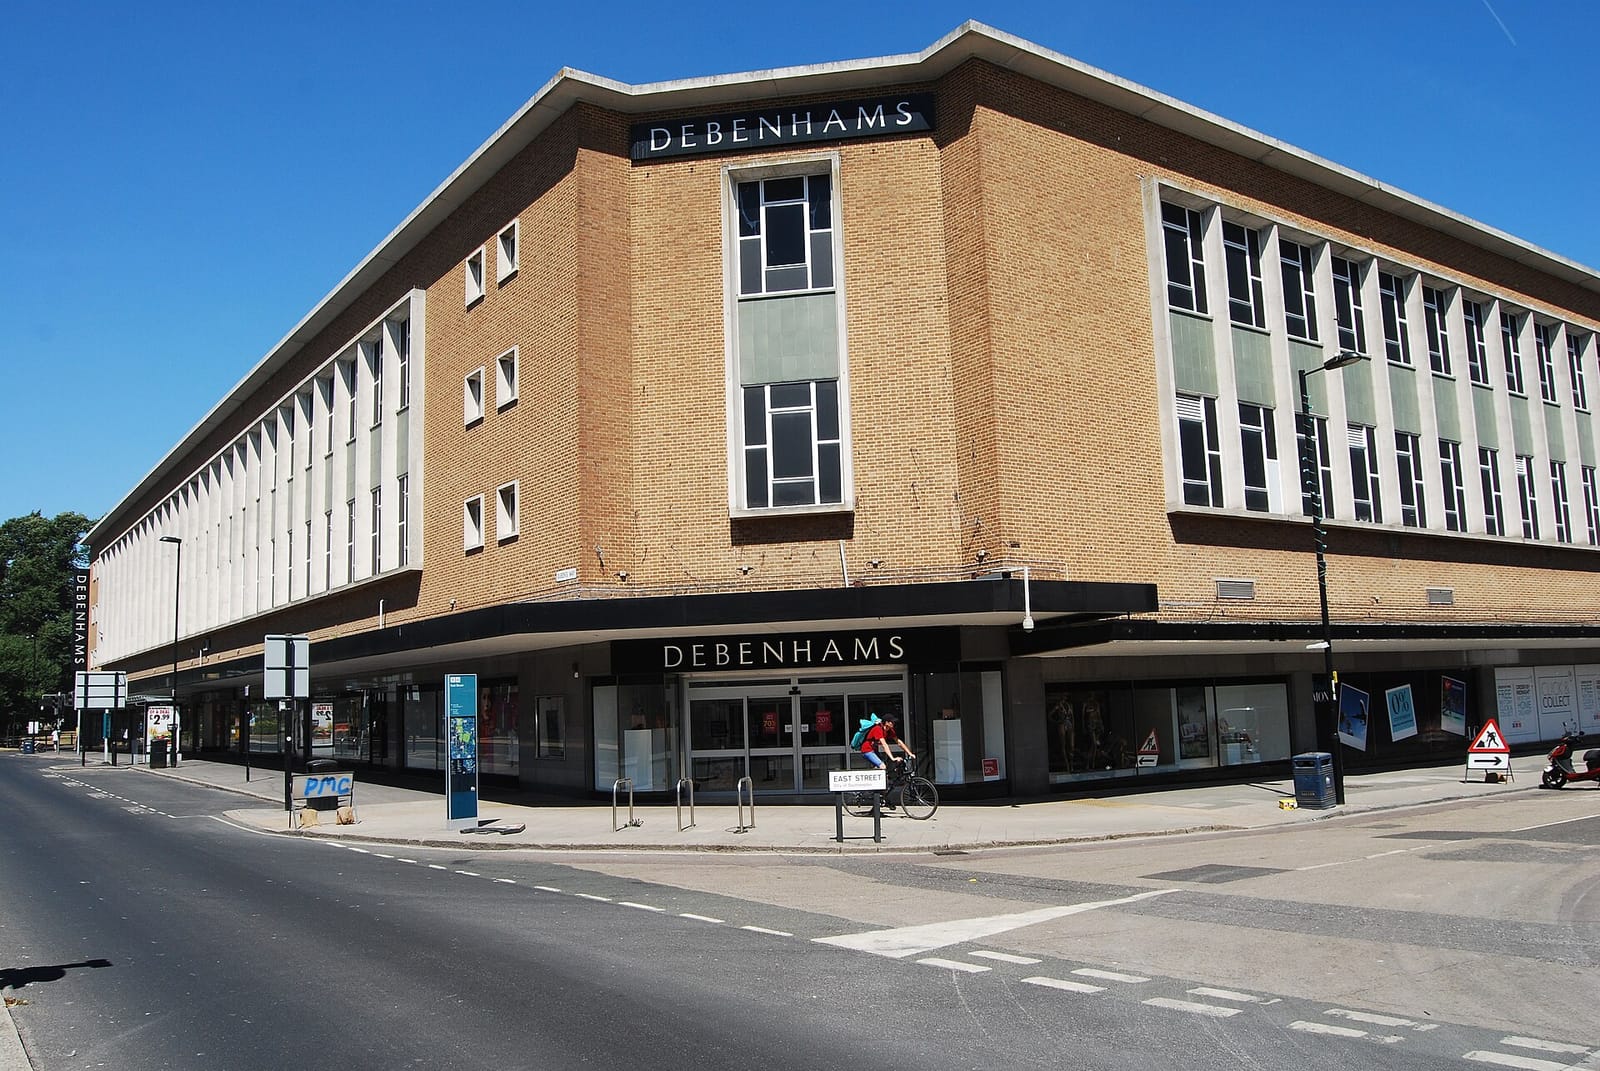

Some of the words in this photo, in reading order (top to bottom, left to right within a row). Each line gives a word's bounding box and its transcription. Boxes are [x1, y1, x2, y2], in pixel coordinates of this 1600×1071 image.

[650, 101, 913, 151] DEBENHAMS
[74, 575, 87, 664] DEBENHAMS
[663, 636, 904, 668] DEBENHAMS
[1392, 689, 1409, 715] 0%
[1543, 696, 1570, 708] COLLECT
